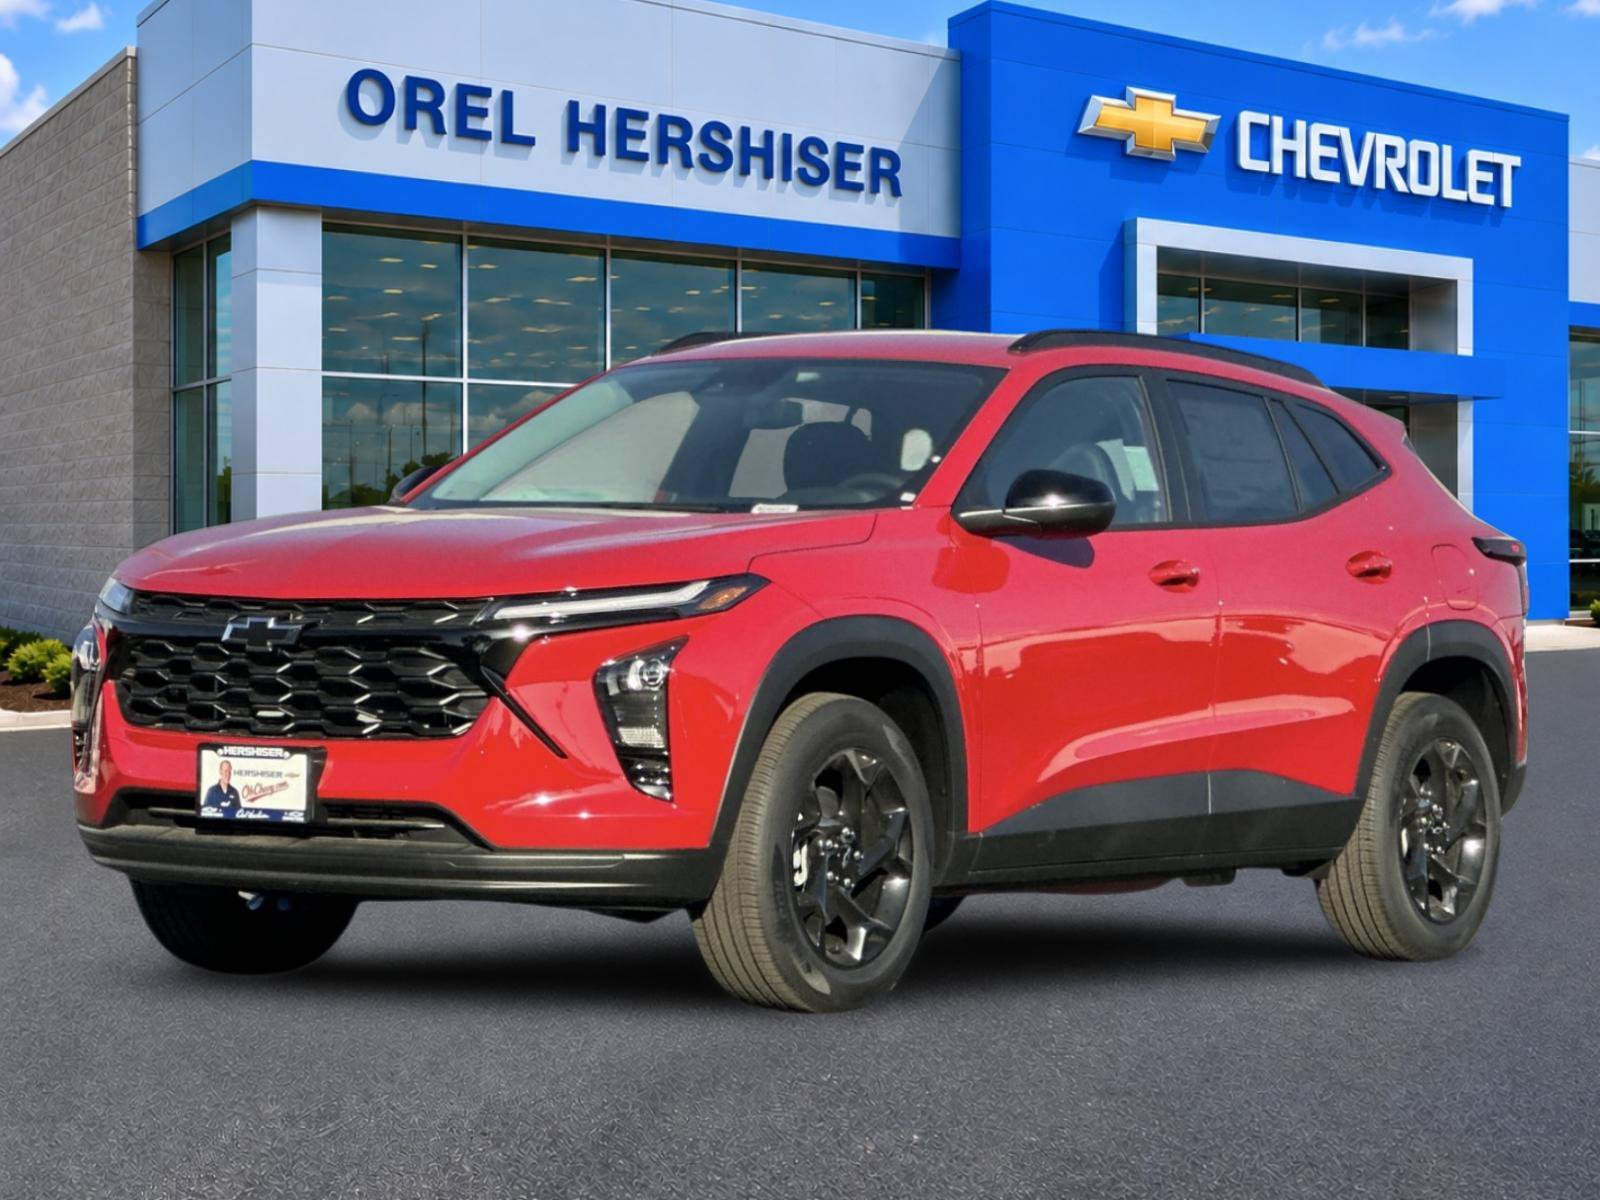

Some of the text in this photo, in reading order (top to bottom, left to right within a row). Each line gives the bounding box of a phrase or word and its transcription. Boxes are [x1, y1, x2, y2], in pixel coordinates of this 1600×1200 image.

[346, 68, 903, 197] OREL HERSHISER
[1237, 110, 1522, 208] CHEVROLET
[223, 746, 284, 757] HERSHISER
[233, 769, 283, 778] HERSHISER
